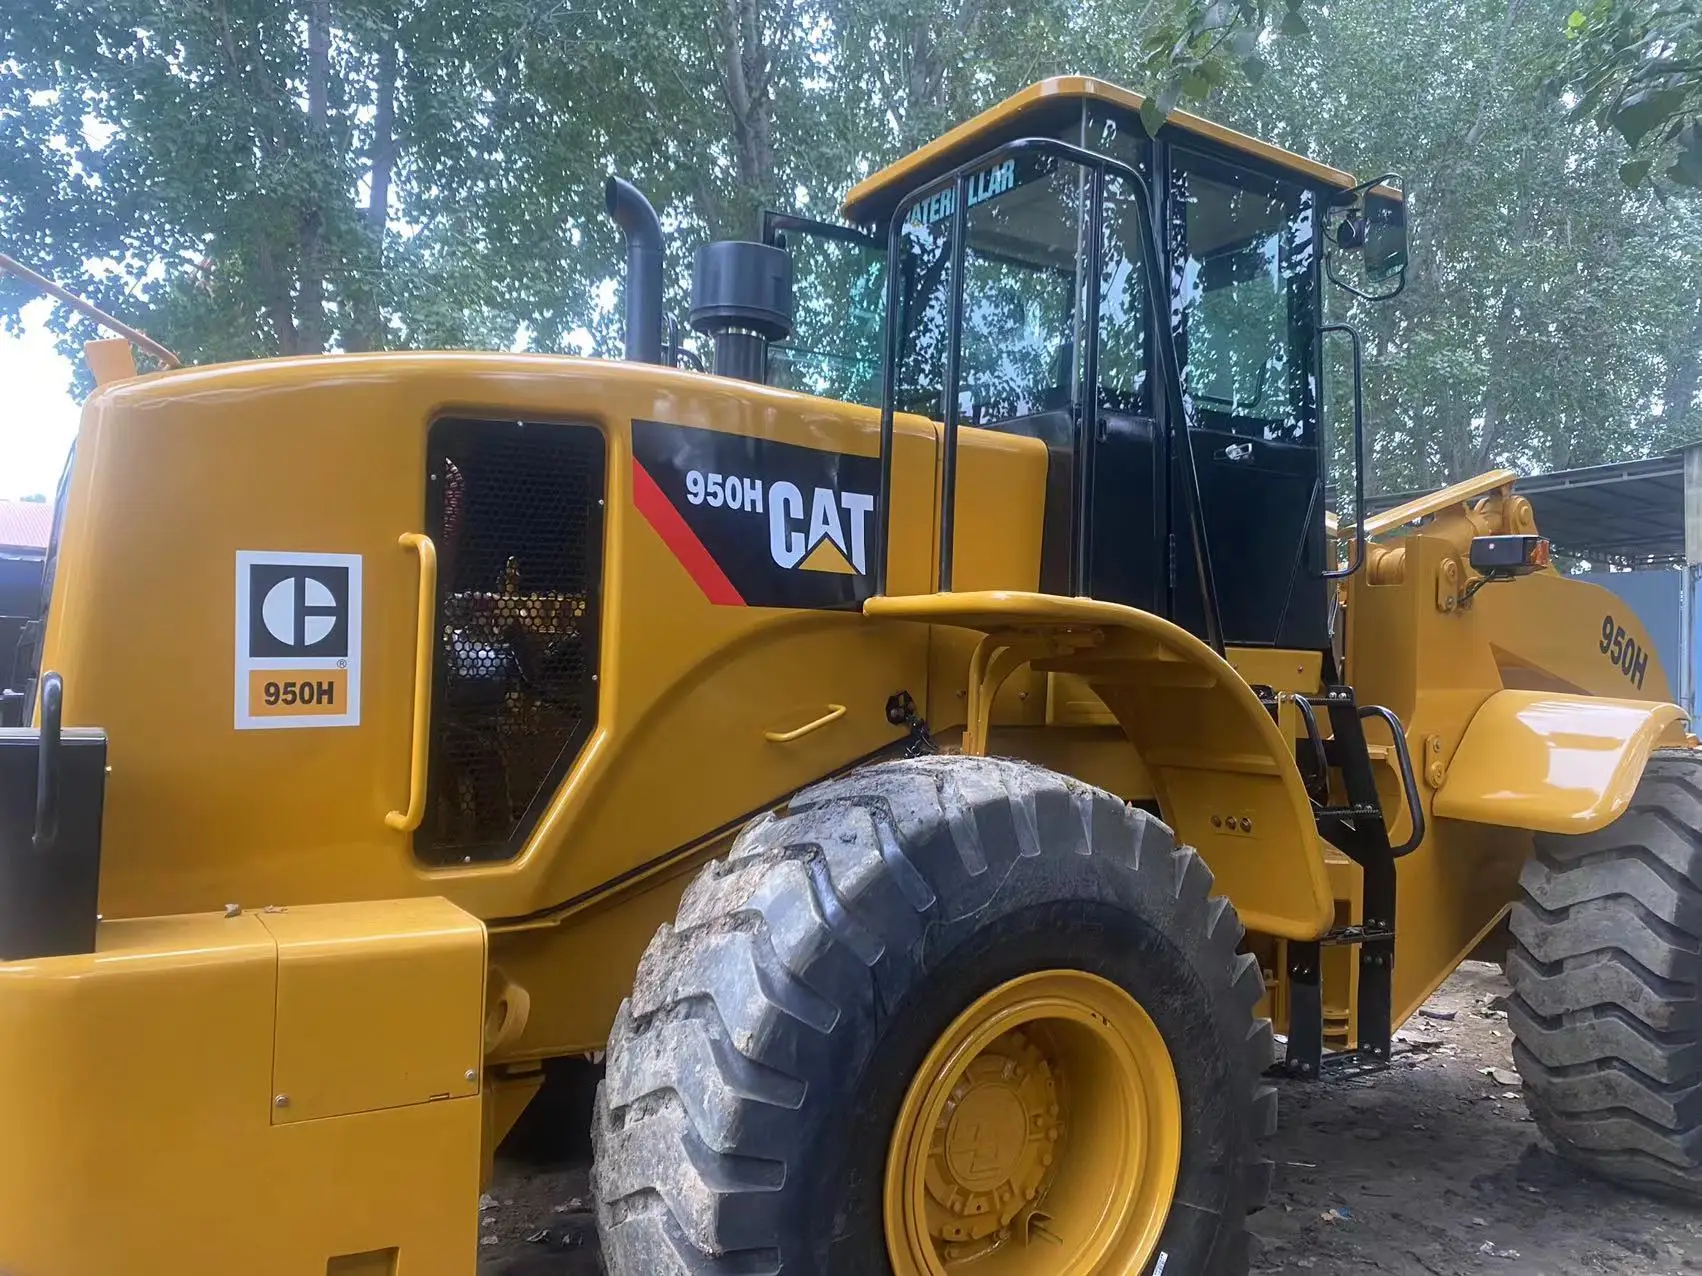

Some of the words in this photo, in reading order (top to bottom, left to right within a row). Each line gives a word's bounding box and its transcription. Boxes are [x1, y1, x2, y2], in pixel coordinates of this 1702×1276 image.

[904, 159, 1015, 225] ATERLLAR
[686, 470, 764, 513] 950H
[768, 481, 874, 576] CAT
[1599, 615, 1648, 691] 950H
[264, 681, 334, 705] 950H
